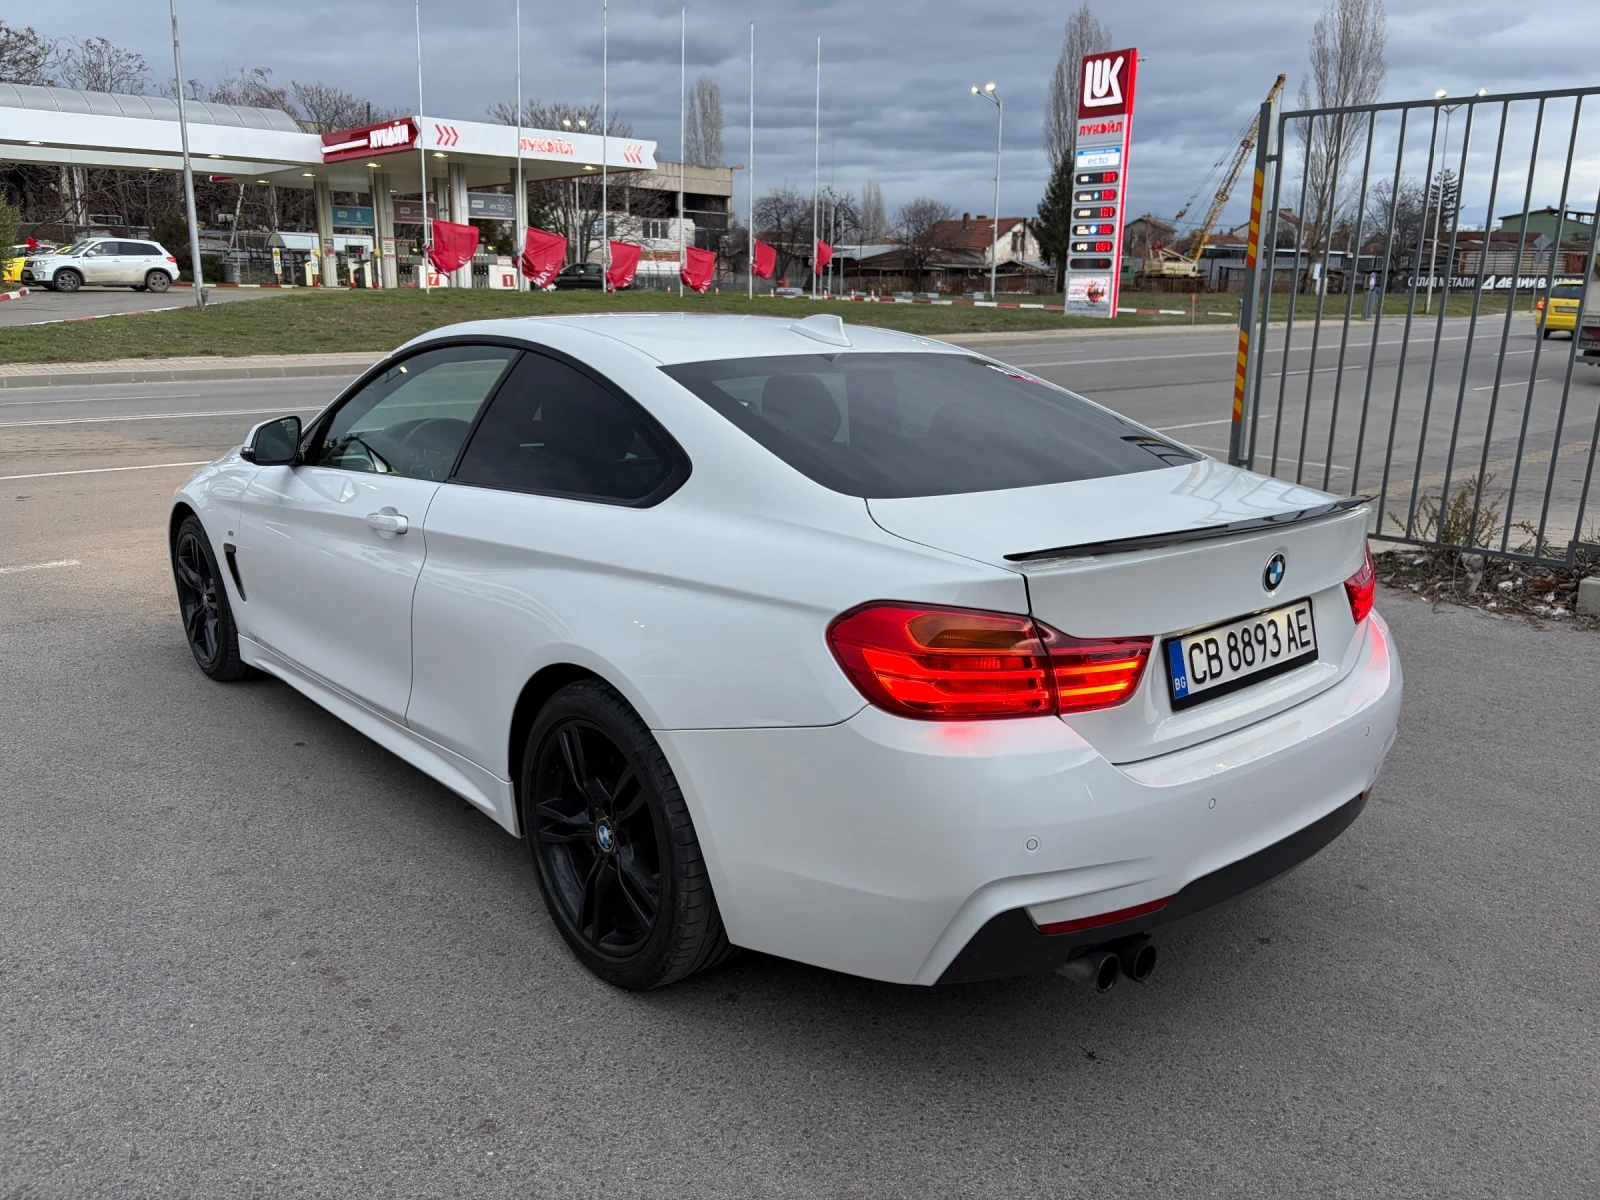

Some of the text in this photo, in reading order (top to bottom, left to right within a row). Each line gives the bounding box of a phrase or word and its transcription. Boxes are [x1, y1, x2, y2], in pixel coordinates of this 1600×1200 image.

[1078, 120, 1123, 136] ЛУКОЙЛ
[1087, 156, 1109, 165] ecto
[429, 274, 438, 285] 7
[1188, 608, 1311, 685] CB 8893 AE
[1174, 677, 1187, 691] BG
